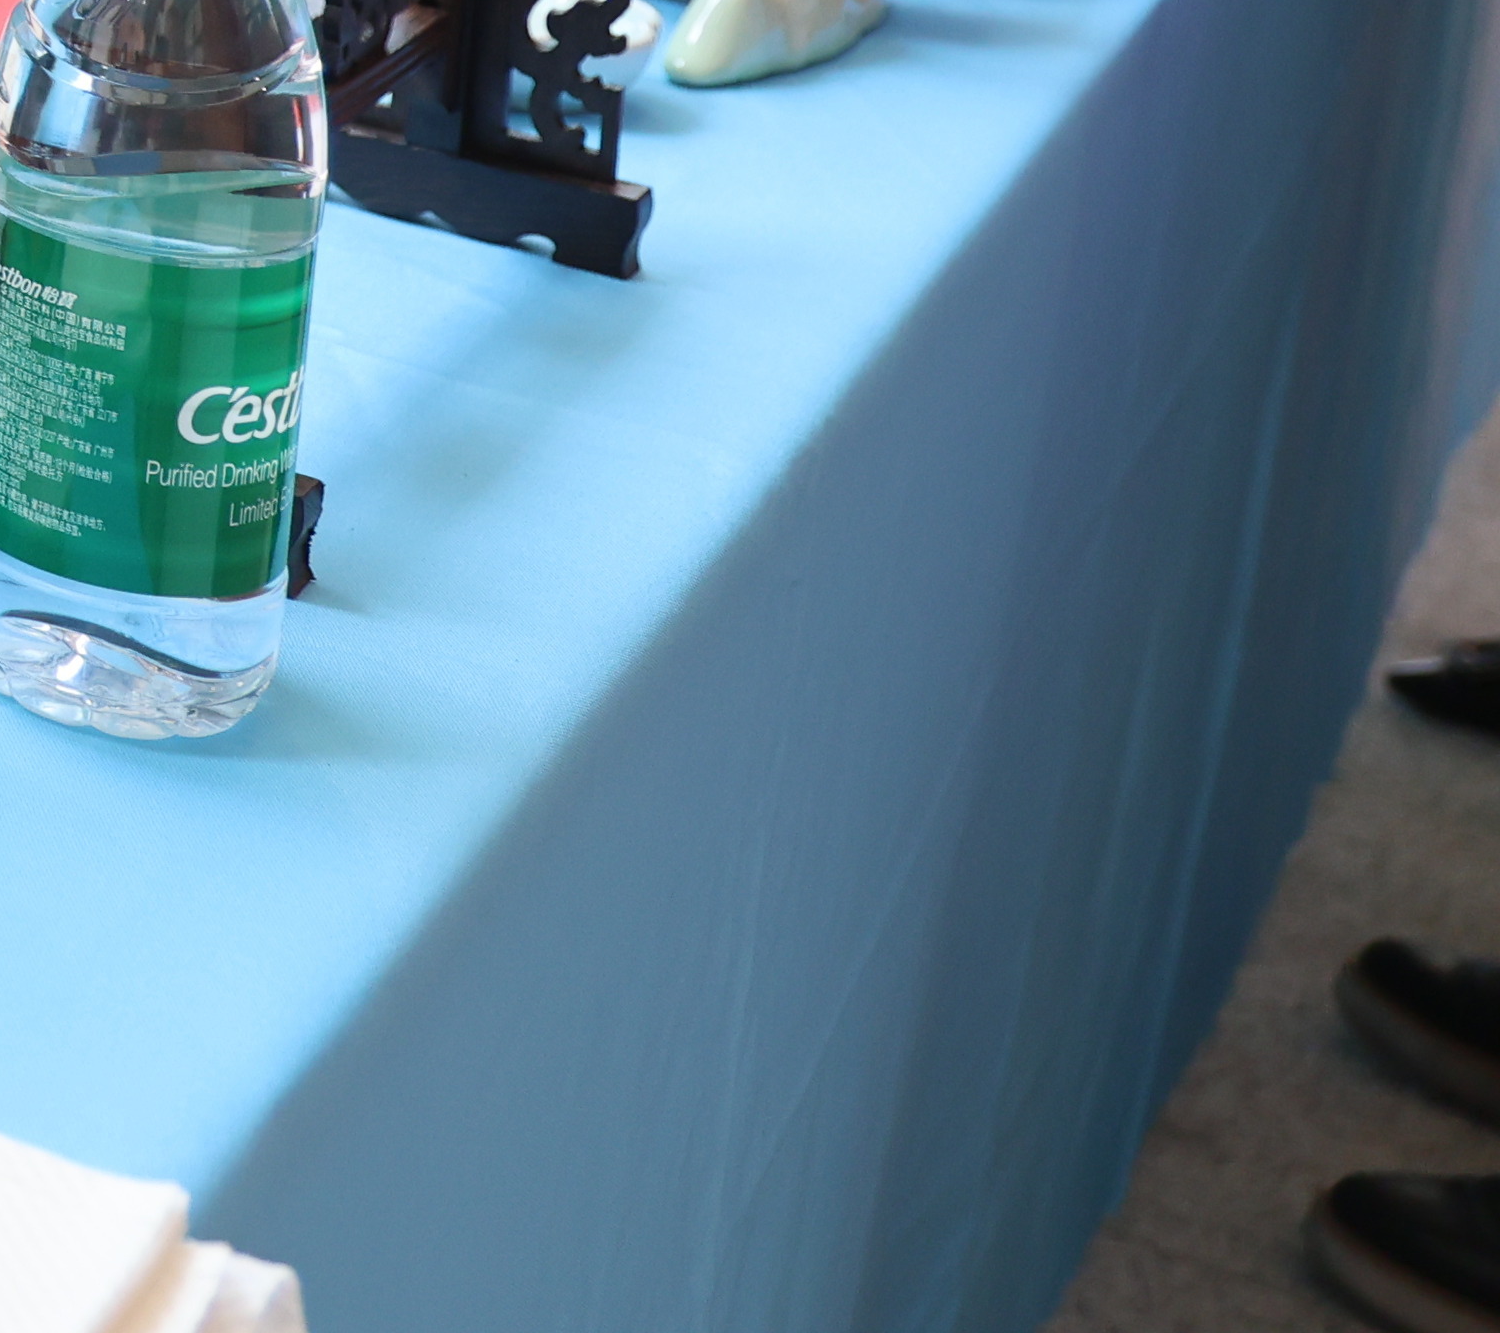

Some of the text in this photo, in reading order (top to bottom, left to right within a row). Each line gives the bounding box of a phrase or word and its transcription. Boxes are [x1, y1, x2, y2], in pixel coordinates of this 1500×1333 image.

[145, 459, 217, 488] Purified
[221, 456, 278, 488] Drinking
[229, 491, 278, 528] Limited
